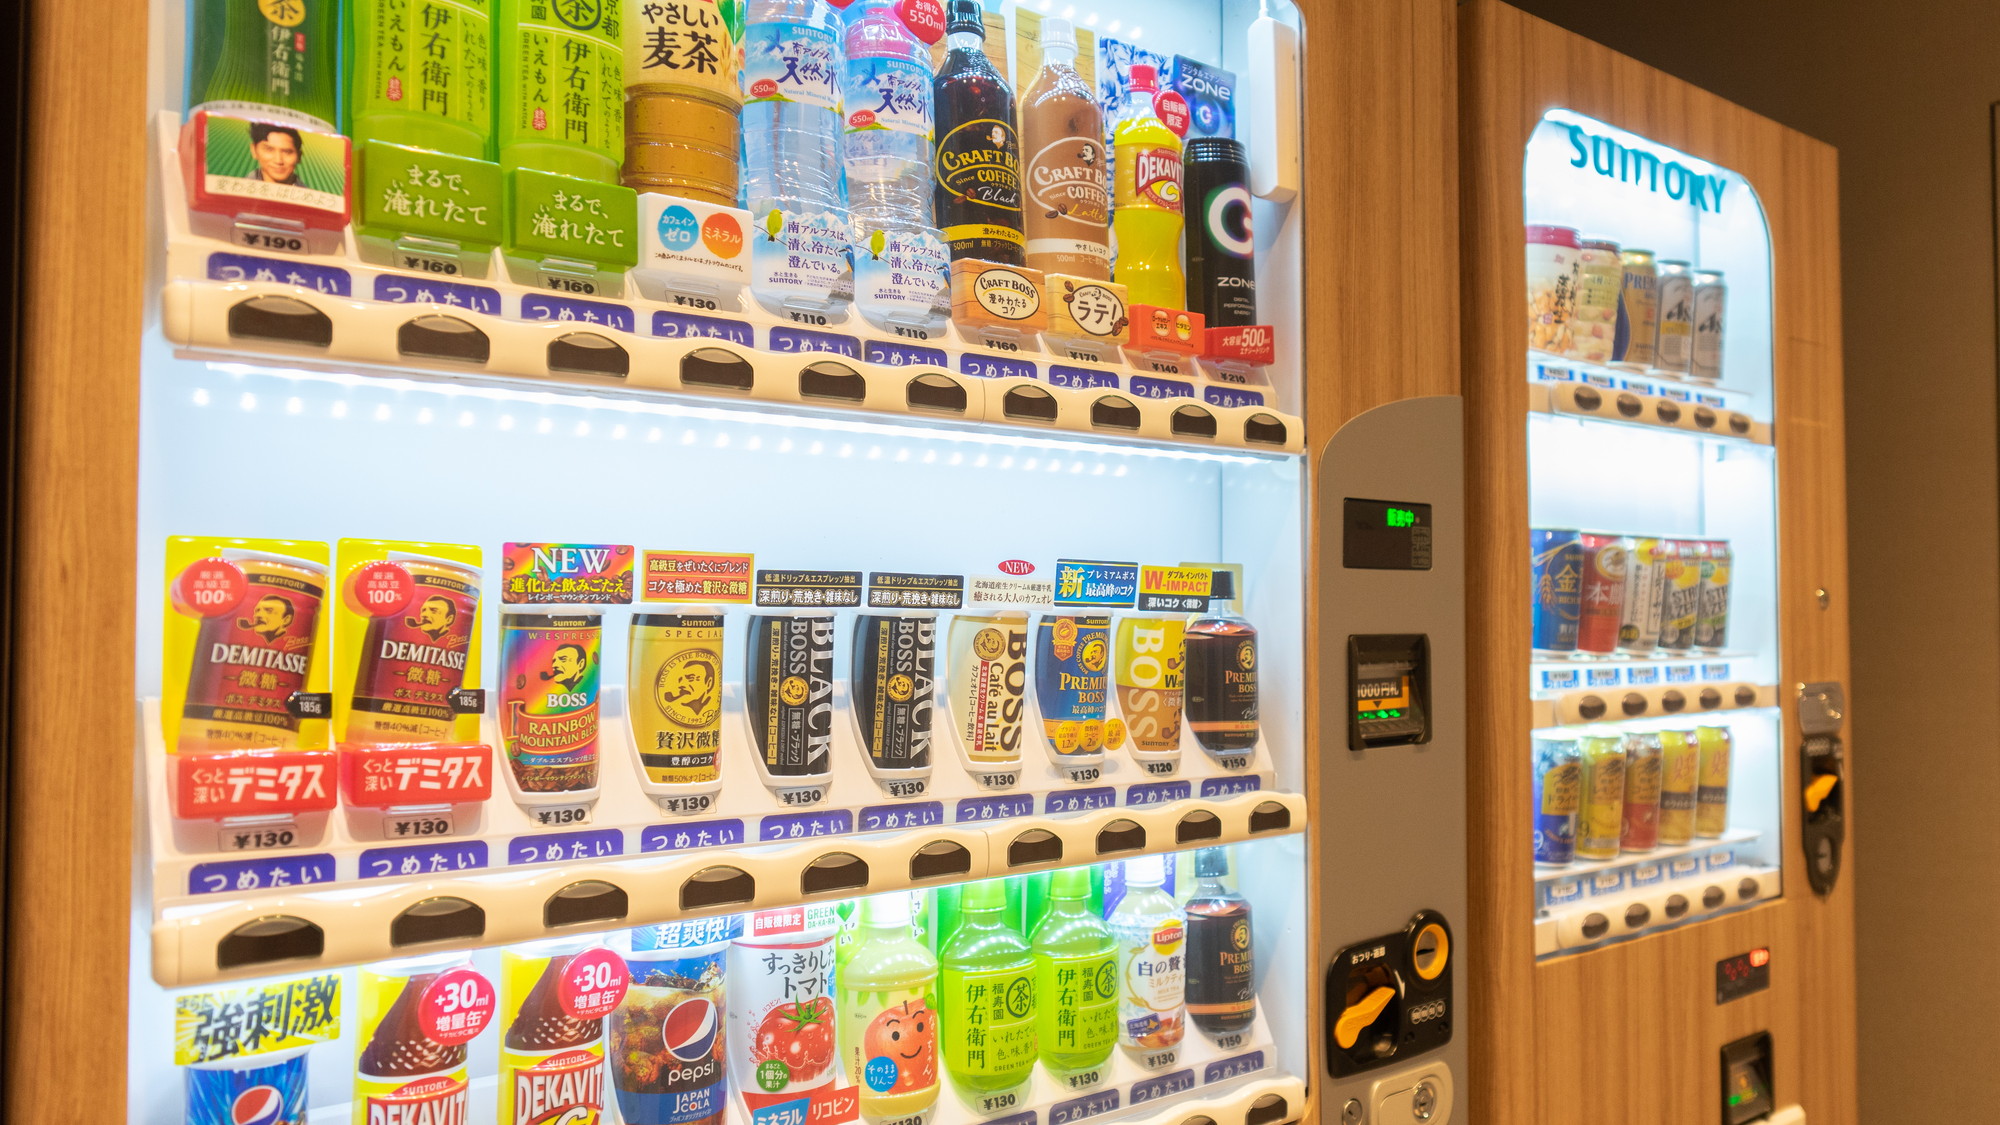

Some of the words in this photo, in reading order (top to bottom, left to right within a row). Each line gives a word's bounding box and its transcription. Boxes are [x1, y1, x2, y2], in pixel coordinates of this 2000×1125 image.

[641, 1, 719, 29] やさしい
[908, 9, 944, 31] 550ml
[421, 3, 453, 117] 伊右衛門
[641, 26, 720, 76] 麦茶
[270, 26, 292, 96] 伊右衛門
[533, 34, 550, 104] いえもん
[562, 38, 592, 145] 伊右衛門
[752, 83, 778, 95] 550ml
[851, 113, 875, 125] 550ml
[942, 149, 1002, 172] CRAFT
[1568, 124, 1728, 214] SUNTORY
[406, 164, 471, 195] まるで、
[1033, 165, 1092, 186] CRAFT
[552, 190, 609, 220] まるで、
[977, 186, 1018, 208] Black
[383, 188, 488, 226] 淹れたて
[531, 211, 625, 248] 淹れたて
[661, 214, 696, 227] カフェイン
[664, 226, 692, 244] ゼロ
[704, 227, 742, 244] ミネラル
[787, 220, 849, 243] 南アルプスは、
[243, 233, 302, 252] ¥190
[787, 238, 844, 260] 清く、冷たく、
[889, 240, 947, 263] 南アルプスは、
[953, 240, 975, 250] 500ml
[404, 255, 457, 275] ¥160
[788, 255, 842, 278] 澄んでいる。
[890, 258, 942, 279] 清く、冷たく、
[548, 277, 595, 296] ¥160
[768, 277, 804, 288] SUNTORY
[891, 272, 941, 295] 澄んでいる。
[979, 277, 1011, 291] CRAFT
[1011, 280, 1036, 300] BOSS
[673, 294, 717, 312] ¥130
[874, 293, 906, 302] SUNTORY
[988, 293, 1028, 310] 澄みわたる
[790, 311, 827, 327] ¥110
[1001, 306, 1018, 321] コク
[1077, 299, 1118, 327] ラテ!
[895, 326, 929, 342] ¥110
[985, 338, 1019, 355] ¥160
[1068, 350, 1099, 365] ¥170
[1151, 361, 1180, 375] ¥140
[1219, 372, 1247, 386] ¥210
[530, 546, 612, 575] NEW
[649, 559, 749, 575] 高級豆をぜいたくにブレンド
[1003, 561, 1033, 575] NEW
[258, 574, 308, 592] SUNTORY
[423, 574, 467, 592] SUNTORY
[508, 576, 627, 595] 進化した飲みごたえ
[763, 573, 857, 585] 低温ドリップ&エスプレッソ抽出
[875, 575, 960, 588] 低温ドリップ&エスプレッソ抽出
[1057, 565, 1085, 601] 新
[1086, 569, 1136, 583] プレミアムボス
[1144, 569, 1209, 593] W-IMPACT
[1167, 570, 1185, 580] ダブル
[1185, 572, 1209, 582] インパクト
[367, 589, 403, 604] 100%
[648, 577, 749, 597] コクを極めた贅沢な微糖
[758, 588, 859, 605] 深煎り・荒挽き・雑味なし
[1084, 581, 1136, 599] 最高峰のコク
[193, 590, 234, 606] 100%
[527, 592, 612, 602] レインボーマウンテンブレンド
[871, 590, 962, 606] 深煎り・荒挽き・雑味なし
[972, 590, 1053, 605] 癒される大人のカフェオレ
[1147, 596, 1180, 609] 深いコク
[552, 619, 588, 628] SUNTORY
[681, 619, 716, 628] SUNTORY
[379, 639, 467, 672] DEMITASSE
[788, 619, 809, 675] BOSS
[895, 620, 916, 673] BOSS
[209, 642, 309, 676] DEMITASSE
[237, 668, 279, 692] 微糖
[406, 665, 444, 687] 微糖
[987, 661, 1005, 698] Café
[1126, 627, 1166, 739] BOSS
[393, 687, 412, 699] ボス
[414, 690, 445, 704] デミタス
[806, 619, 834, 767] BLACK
[910, 619, 936, 760] BLACK
[1000, 629, 1028, 752] BOSS
[223, 693, 244, 706] ボス
[249, 694, 282, 710] デミタス
[298, 701, 322, 717] 185g
[458, 695, 478, 709] 185g
[546, 692, 589, 709] BOSS
[986, 700, 999, 720] au
[528, 708, 597, 736] RAINBOW
[518, 731, 581, 749] MOUNTAIN
[983, 722, 1000, 753] Lait
[1141, 739, 1171, 748] SUNTORY
[1147, 762, 1174, 776] ¥120
[1221, 755, 1247, 770] ¥150
[226, 763, 328, 804] デミタス
[364, 774, 395, 793] 深い
[394, 755, 485, 793] デミタス
[982, 773, 1016, 787] ¥130
[1070, 767, 1101, 783] ¥130
[191, 785, 226, 805] 深い
[782, 788, 823, 805] ¥130
[889, 781, 925, 797] ¥130
[666, 795, 711, 813] ¥130
[963, 800, 1028, 821] つめたい
[537, 807, 587, 825] ¥130
[866, 809, 936, 830] つめたい
[394, 819, 450, 837] ¥130
[768, 818, 845, 841] つめたい
[233, 830, 295, 850] ¥130
[650, 829, 736, 852] つめたい
[370, 850, 477, 878] つめたい
[202, 863, 324, 894] つめたい
[754, 911, 803, 932] 自販機限定
[807, 904, 836, 921] GREEN
[653, 914, 732, 951] 超爽快!
[1155, 930, 1184, 943] Lipton
[573, 961, 622, 993] +30ml
[783, 971, 829, 1000] トマト
[1081, 967, 1095, 1002] 福寿園
[1098, 966, 1118, 994] 茶
[434, 978, 490, 1014] +30ml
[992, 982, 1005, 1021] 福寿園
[1010, 983, 1030, 1013] 茶
[1056, 967, 1078, 1048] 伊右衛門
[191, 974, 341, 1064] 強刺激
[966, 983, 988, 1069] 伊右衛門
[1216, 1034, 1243, 1051] ¥150
[545, 1052, 588, 1068] SUNTORY
[765, 1062, 782, 1071] まるごと
[866, 1062, 897, 1076] そのまま
[993, 1061, 1012, 1073] GREEN
[1012, 1059, 1027, 1070] TEA
[1147, 1051, 1176, 1069] ¥130
[667, 1060, 716, 1087] pepsi
[759, 1068, 789, 1083] 1個分の
[869, 1072, 897, 1088] りんご
[1069, 1071, 1100, 1088] ¥130
[401, 1079, 449, 1096] SUNTORY
[764, 1079, 782, 1091] 果汁
[1134, 1076, 1190, 1102] つめたい
[672, 1087, 711, 1115] JAPAN
[680, 1097, 711, 1114] COLA
[812, 1096, 856, 1123] リコピン
[983, 1092, 1017, 1111] ¥130
[1056, 1097, 1114, 1123] つめたい
